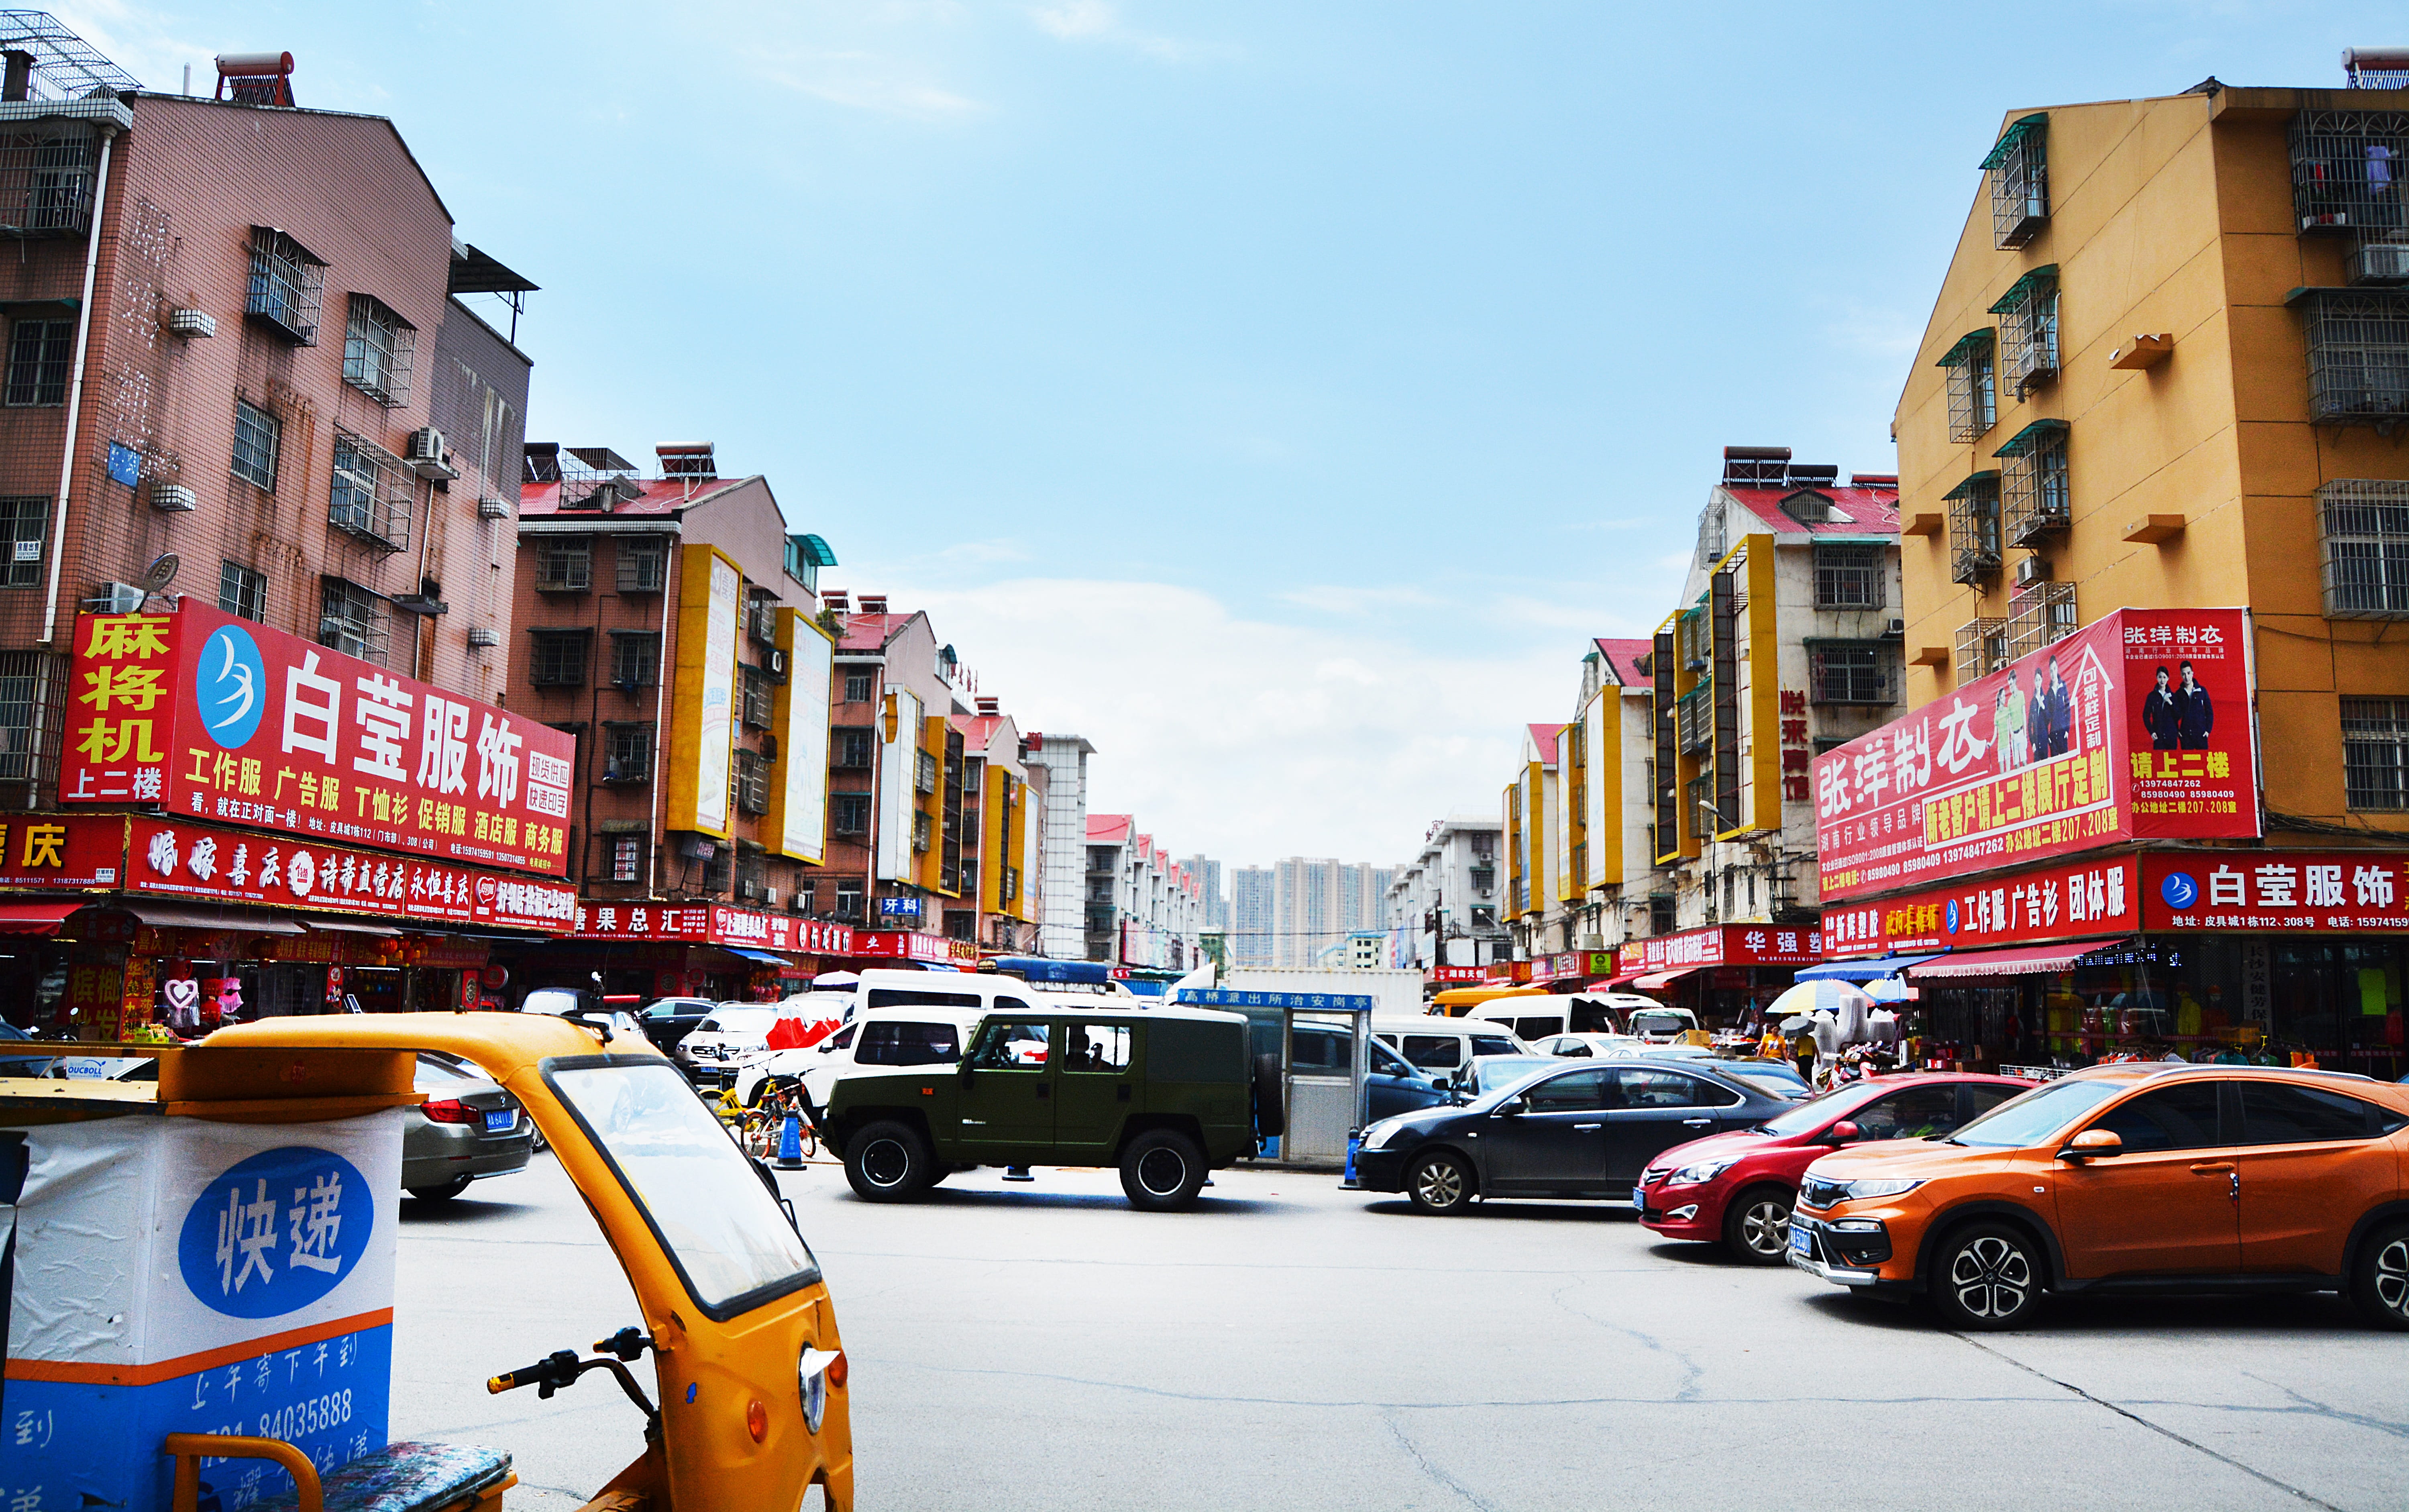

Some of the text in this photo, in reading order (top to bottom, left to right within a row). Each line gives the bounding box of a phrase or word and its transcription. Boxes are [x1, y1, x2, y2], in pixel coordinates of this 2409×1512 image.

[2124, 625, 2224, 645] 张洋制衣
[76, 616, 170, 763] 麻将机
[2083, 666, 2102, 749] 可来样定制
[282, 649, 522, 809] 白莹服饰
[1780, 690, 1810, 801] 悦来宾馆
[531, 754, 569, 786] 现货供应
[1819, 697, 1987, 818] 张洋制衣
[2130, 751, 2230, 779] 请上二楼
[67, 767, 161, 799] 上二楼
[185, 748, 563, 855] 工作服 广告服 T恤衫 促销服 酒店服 商务服
[529, 785, 567, 815] 快速印字
[1926, 746, 2108, 844] 新老客户请上二楼展厅定制
[1821, 803, 1921, 852] 湖南行业领导品牌
[2131, 801, 2237, 814] 办公地址二楼207、208室
[0, 823, 65, 867] 庆
[496, 852, 525, 865] 13507314855
[1867, 862, 1900, 881] 85980490
[1903, 853, 1940, 873] 85980409
[1943, 837, 2004, 864] 13974847262
[2005, 807, 2118, 854] 办公地址二楼207、208室
[410, 867, 469, 905] 永恒喜庆
[884, 898, 917, 912] 牙科
[1964, 866, 2125, 934] 工作服 广告衫 团体服
[2210, 864, 2394, 908] 白莹服饰
[71, 967, 120, 1005] 槟榔
[1185, 990, 1368, 1009] 高桥派出所治安岗亭
[215, 1170, 342, 1296] 快递
[191, 1332, 357, 1410] 上午寄下午到
[15, 1409, 53, 1449] 到
[259, 1388, 352, 1441] 84035888
